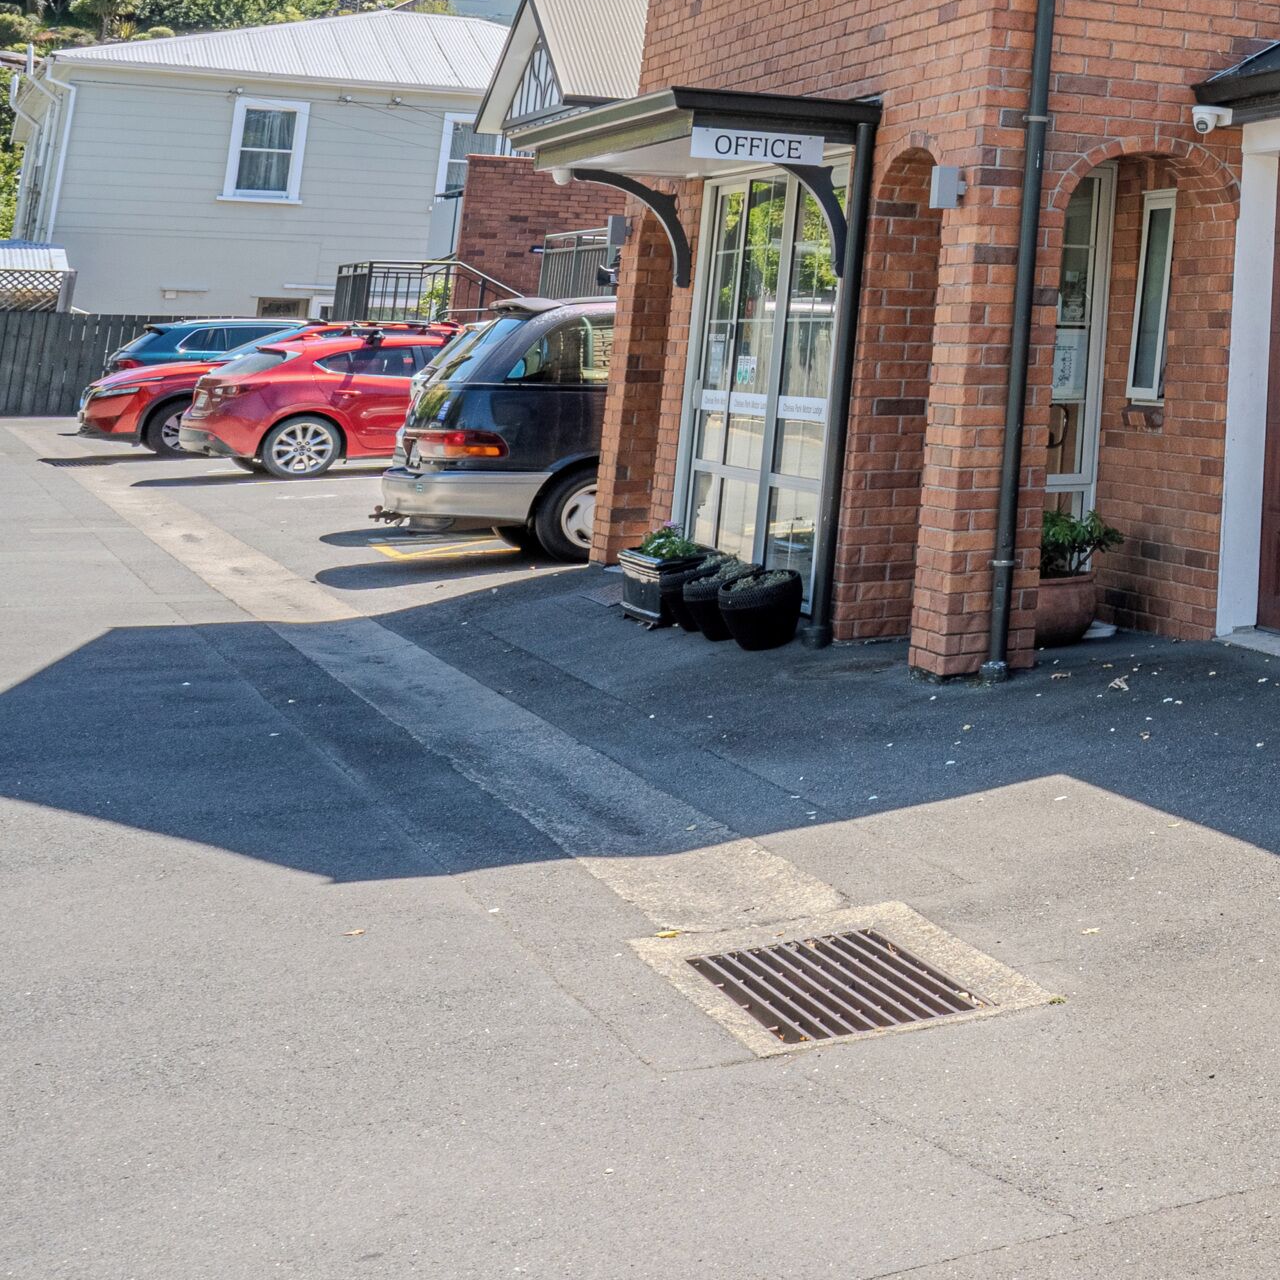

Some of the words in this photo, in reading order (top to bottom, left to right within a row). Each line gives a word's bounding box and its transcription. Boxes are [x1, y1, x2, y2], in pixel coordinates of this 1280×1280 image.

[714, 134, 802, 160] OFFICE
[783, 403, 794, 413] Chelsea
[802, 405, 812, 414] Motor
[812, 406, 823, 417] Lodge
